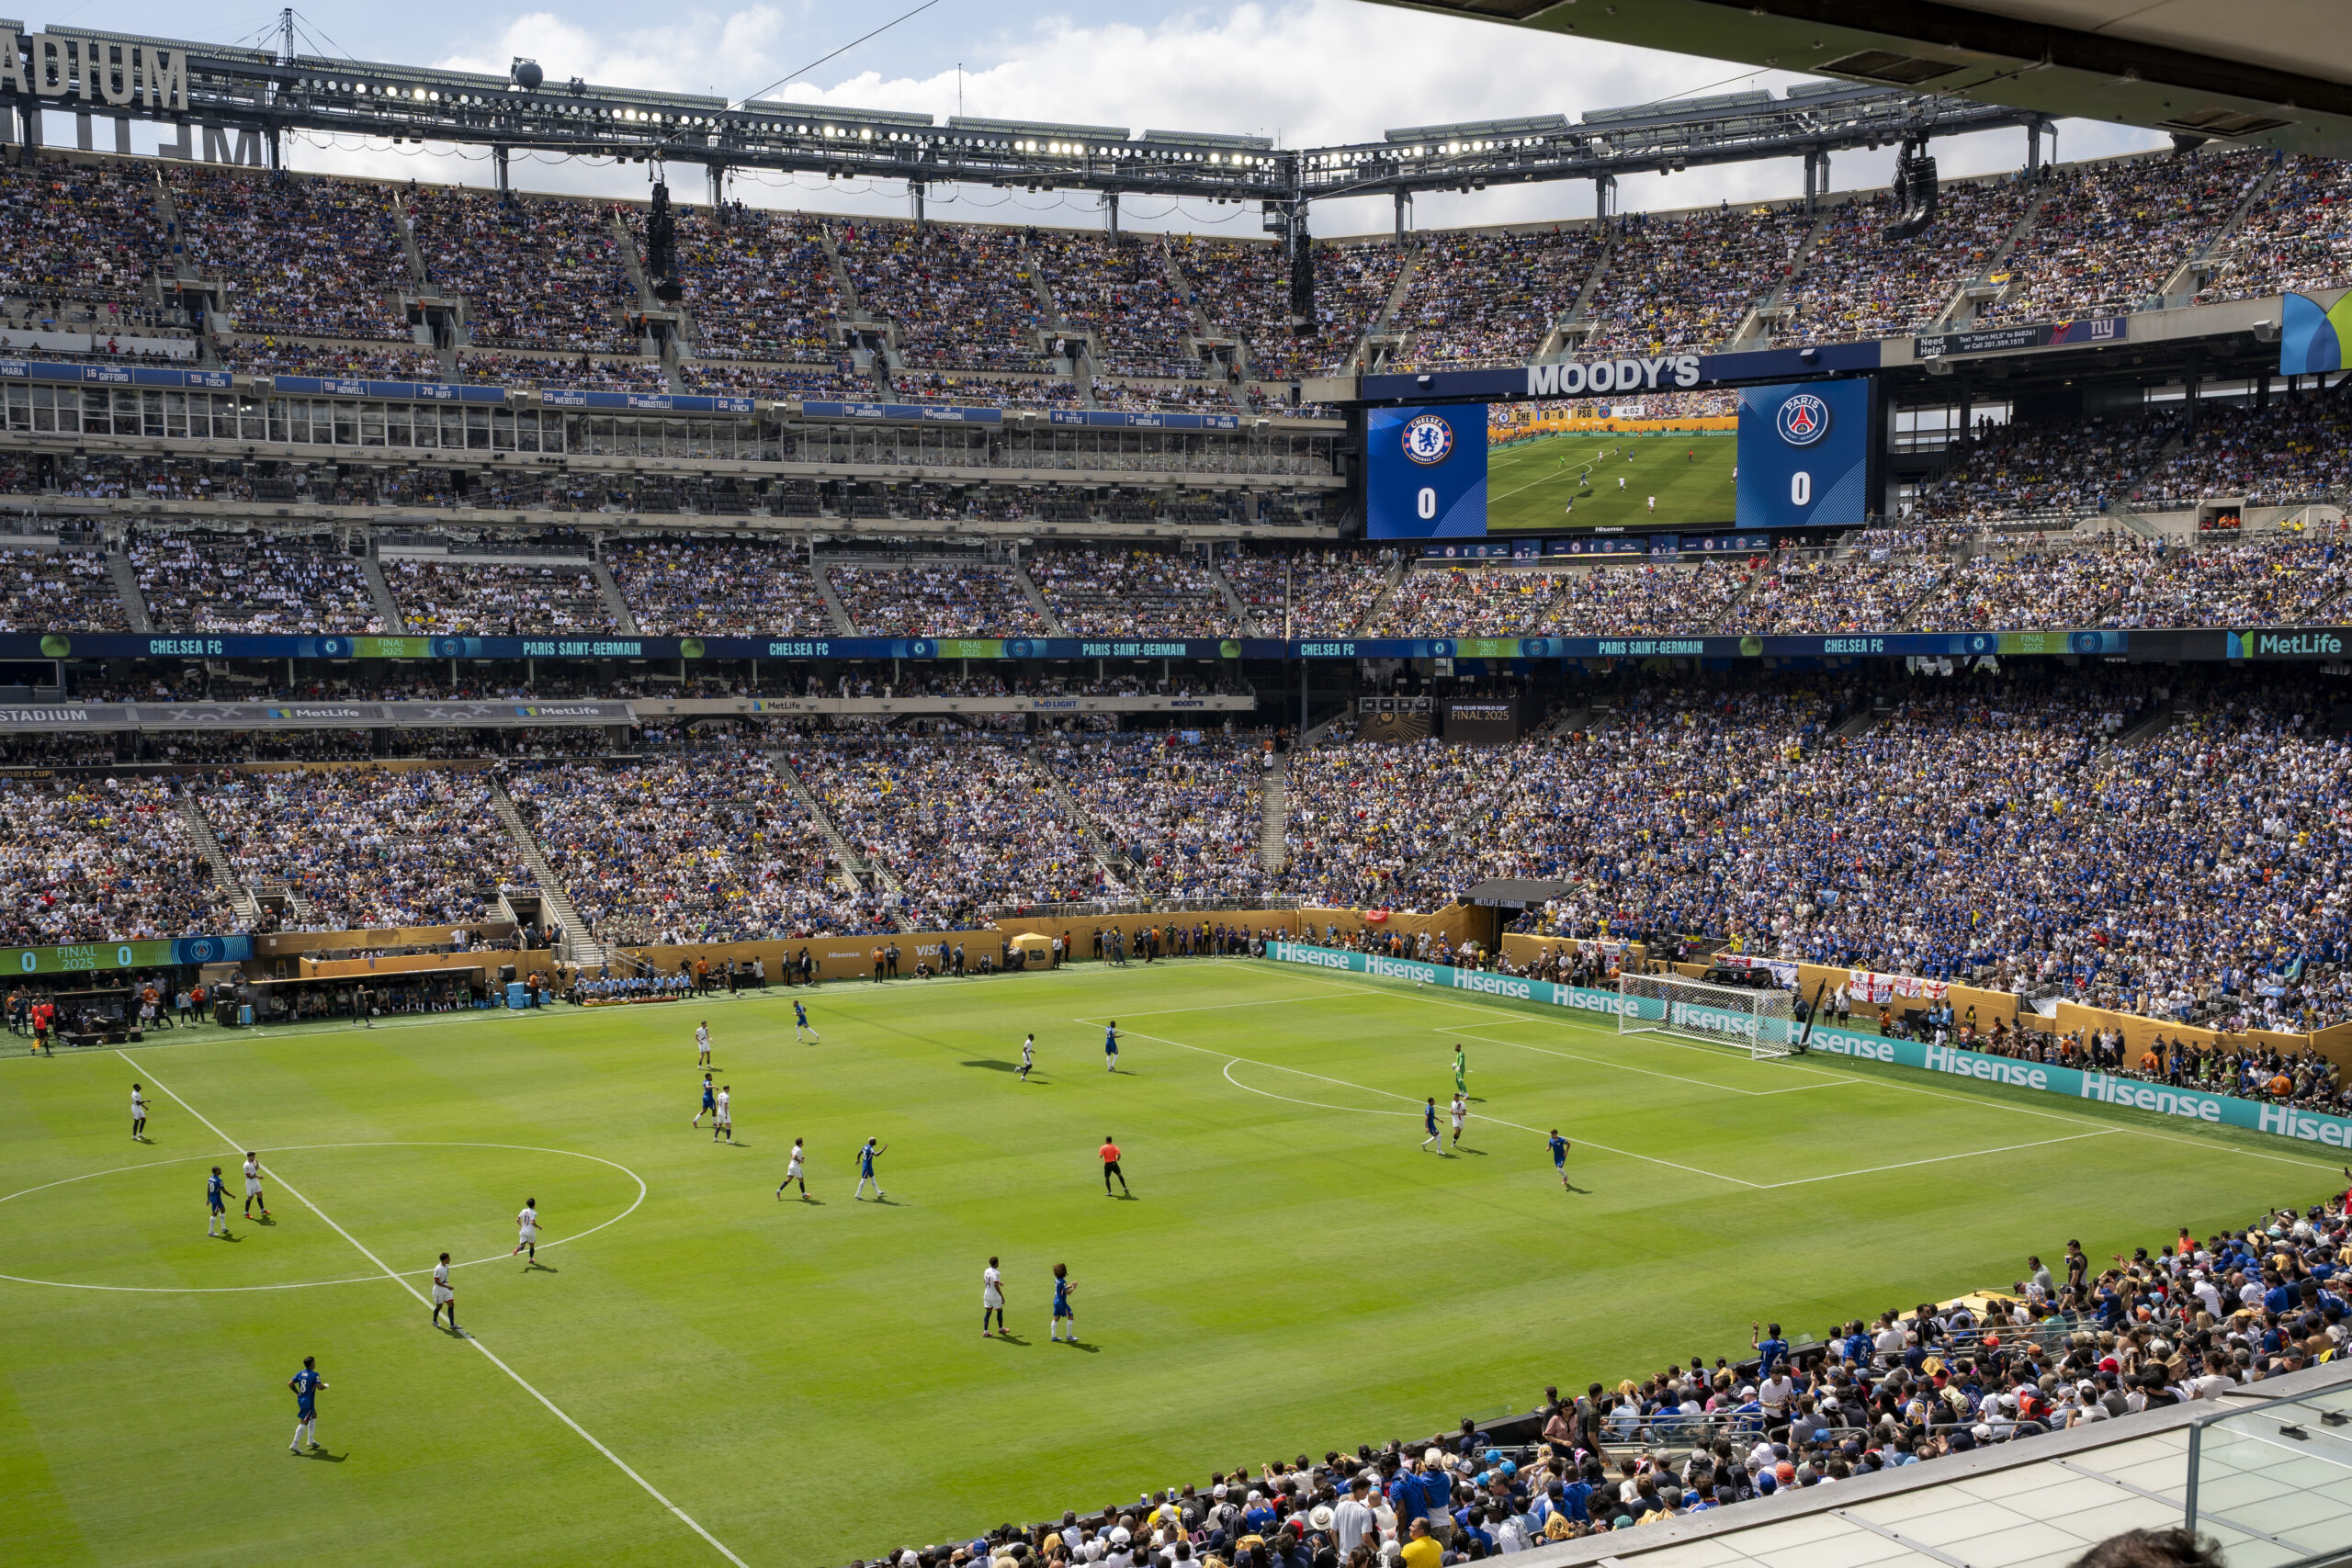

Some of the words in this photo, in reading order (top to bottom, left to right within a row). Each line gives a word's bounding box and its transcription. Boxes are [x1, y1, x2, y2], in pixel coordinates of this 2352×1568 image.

[1920, 336, 1944, 346] Need
[1920, 344, 1947, 355] Help?
[1, 367, 24, 376] MARA
[86, 368, 96, 378] 16
[99, 372, 129, 381] GIFFORD
[1527, 355, 1700, 397] MOODY'S
[205, 378, 226, 387] TISCH
[337, 385, 365, 395] HOWELL
[423, 387, 434, 395] 70
[435, 390, 452, 400] HUFF
[543, 393, 553, 401] 29
[554, 396, 584, 405] WEBSTER
[629, 397, 638, 405] 81
[638, 400, 670, 409] ROBUSTELLI
[718, 400, 728, 409] 22
[729, 403, 750, 412] LYNCH
[1785, 397, 1819, 411] PARIS
[854, 409, 882, 417] JOHNSON
[933, 412, 962, 420] MORRISON
[1516, 412, 1531, 422] CHE
[1544, 411, 1550, 420] 0
[1558, 411, 1565, 420] 0
[1577, 409, 1592, 418] PSG
[1622, 407, 1640, 415] 4:02
[1065, 416, 1083, 424] TITTLE
[1136, 418, 1160, 426] GOGOLAK
[1411, 416, 1443, 428] CHELSEA
[1791, 471, 1811, 506] 0
[1418, 487, 1435, 520] 0
[378, 638, 405, 648] FINAL
[1476, 640, 1498, 649] FINAL
[2020, 635, 2045, 644] FINAL
[2259, 633, 2342, 654] MetLife
[150, 639, 204, 655] CHELSEA
[208, 639, 222, 654] FC
[523, 641, 555, 657] PARIS
[559, 641, 641, 656] SAINT-GERMAIN
[769, 642, 812, 657] CHELSEA
[817, 642, 829, 656] FC
[959, 641, 982, 649] FINAL
[1082, 642, 1110, 657] PARIS
[1114, 642, 1186, 657] SAINT-GERMAIN
[1300, 643, 1340, 657] CHELSEA
[1343, 643, 1355, 656] FC
[1599, 641, 1626, 655] PARIS
[1629, 640, 1703, 655] SAINT-GERMAIN
[1825, 638, 1868, 653] CHELSEA
[1871, 638, 1883, 652] FC
[2022, 643, 2043, 652] 2025
[381, 647, 403, 656] 2025
[962, 649, 980, 657] 2025
[1478, 648, 1498, 656] 2025
[768, 701, 800, 710] MetLife
[1034, 699, 1051, 709] BUD
[1052, 699, 1078, 709] LIGHT
[0, 709, 87, 722] STADIUM
[297, 708, 359, 717] MetLife
[541, 705, 599, 716] MetLife
[1452, 711, 1483, 721] FINAL
[1485, 711, 1510, 721] 2025
[1475, 897, 1499, 908] METLIFE
[1500, 899, 1526, 908] STADIUM
[57, 945, 97, 959] FINAL
[117, 945, 132, 966] 0
[828, 951, 861, 959] Hisense
[21, 952, 37, 973] 0
[62, 957, 96, 971] 2025
[1853, 982, 1889, 992] CHELSEA
[1276, 942, 1349, 969] Hisense
[1365, 953, 1434, 983] Hisense
[1453, 967, 1530, 998] Hisense
[1553, 984, 1638, 1017] Hisense
[1787, 1021, 1894, 1062] Hisense
[1925, 1044, 2047, 1090] Hisense
[2081, 1072, 2221, 1122] Hisense
[1860, 1346, 1867, 1360] 8
[1772, 1353, 1782, 1366] 6
[300, 1379, 307, 1393] 8
